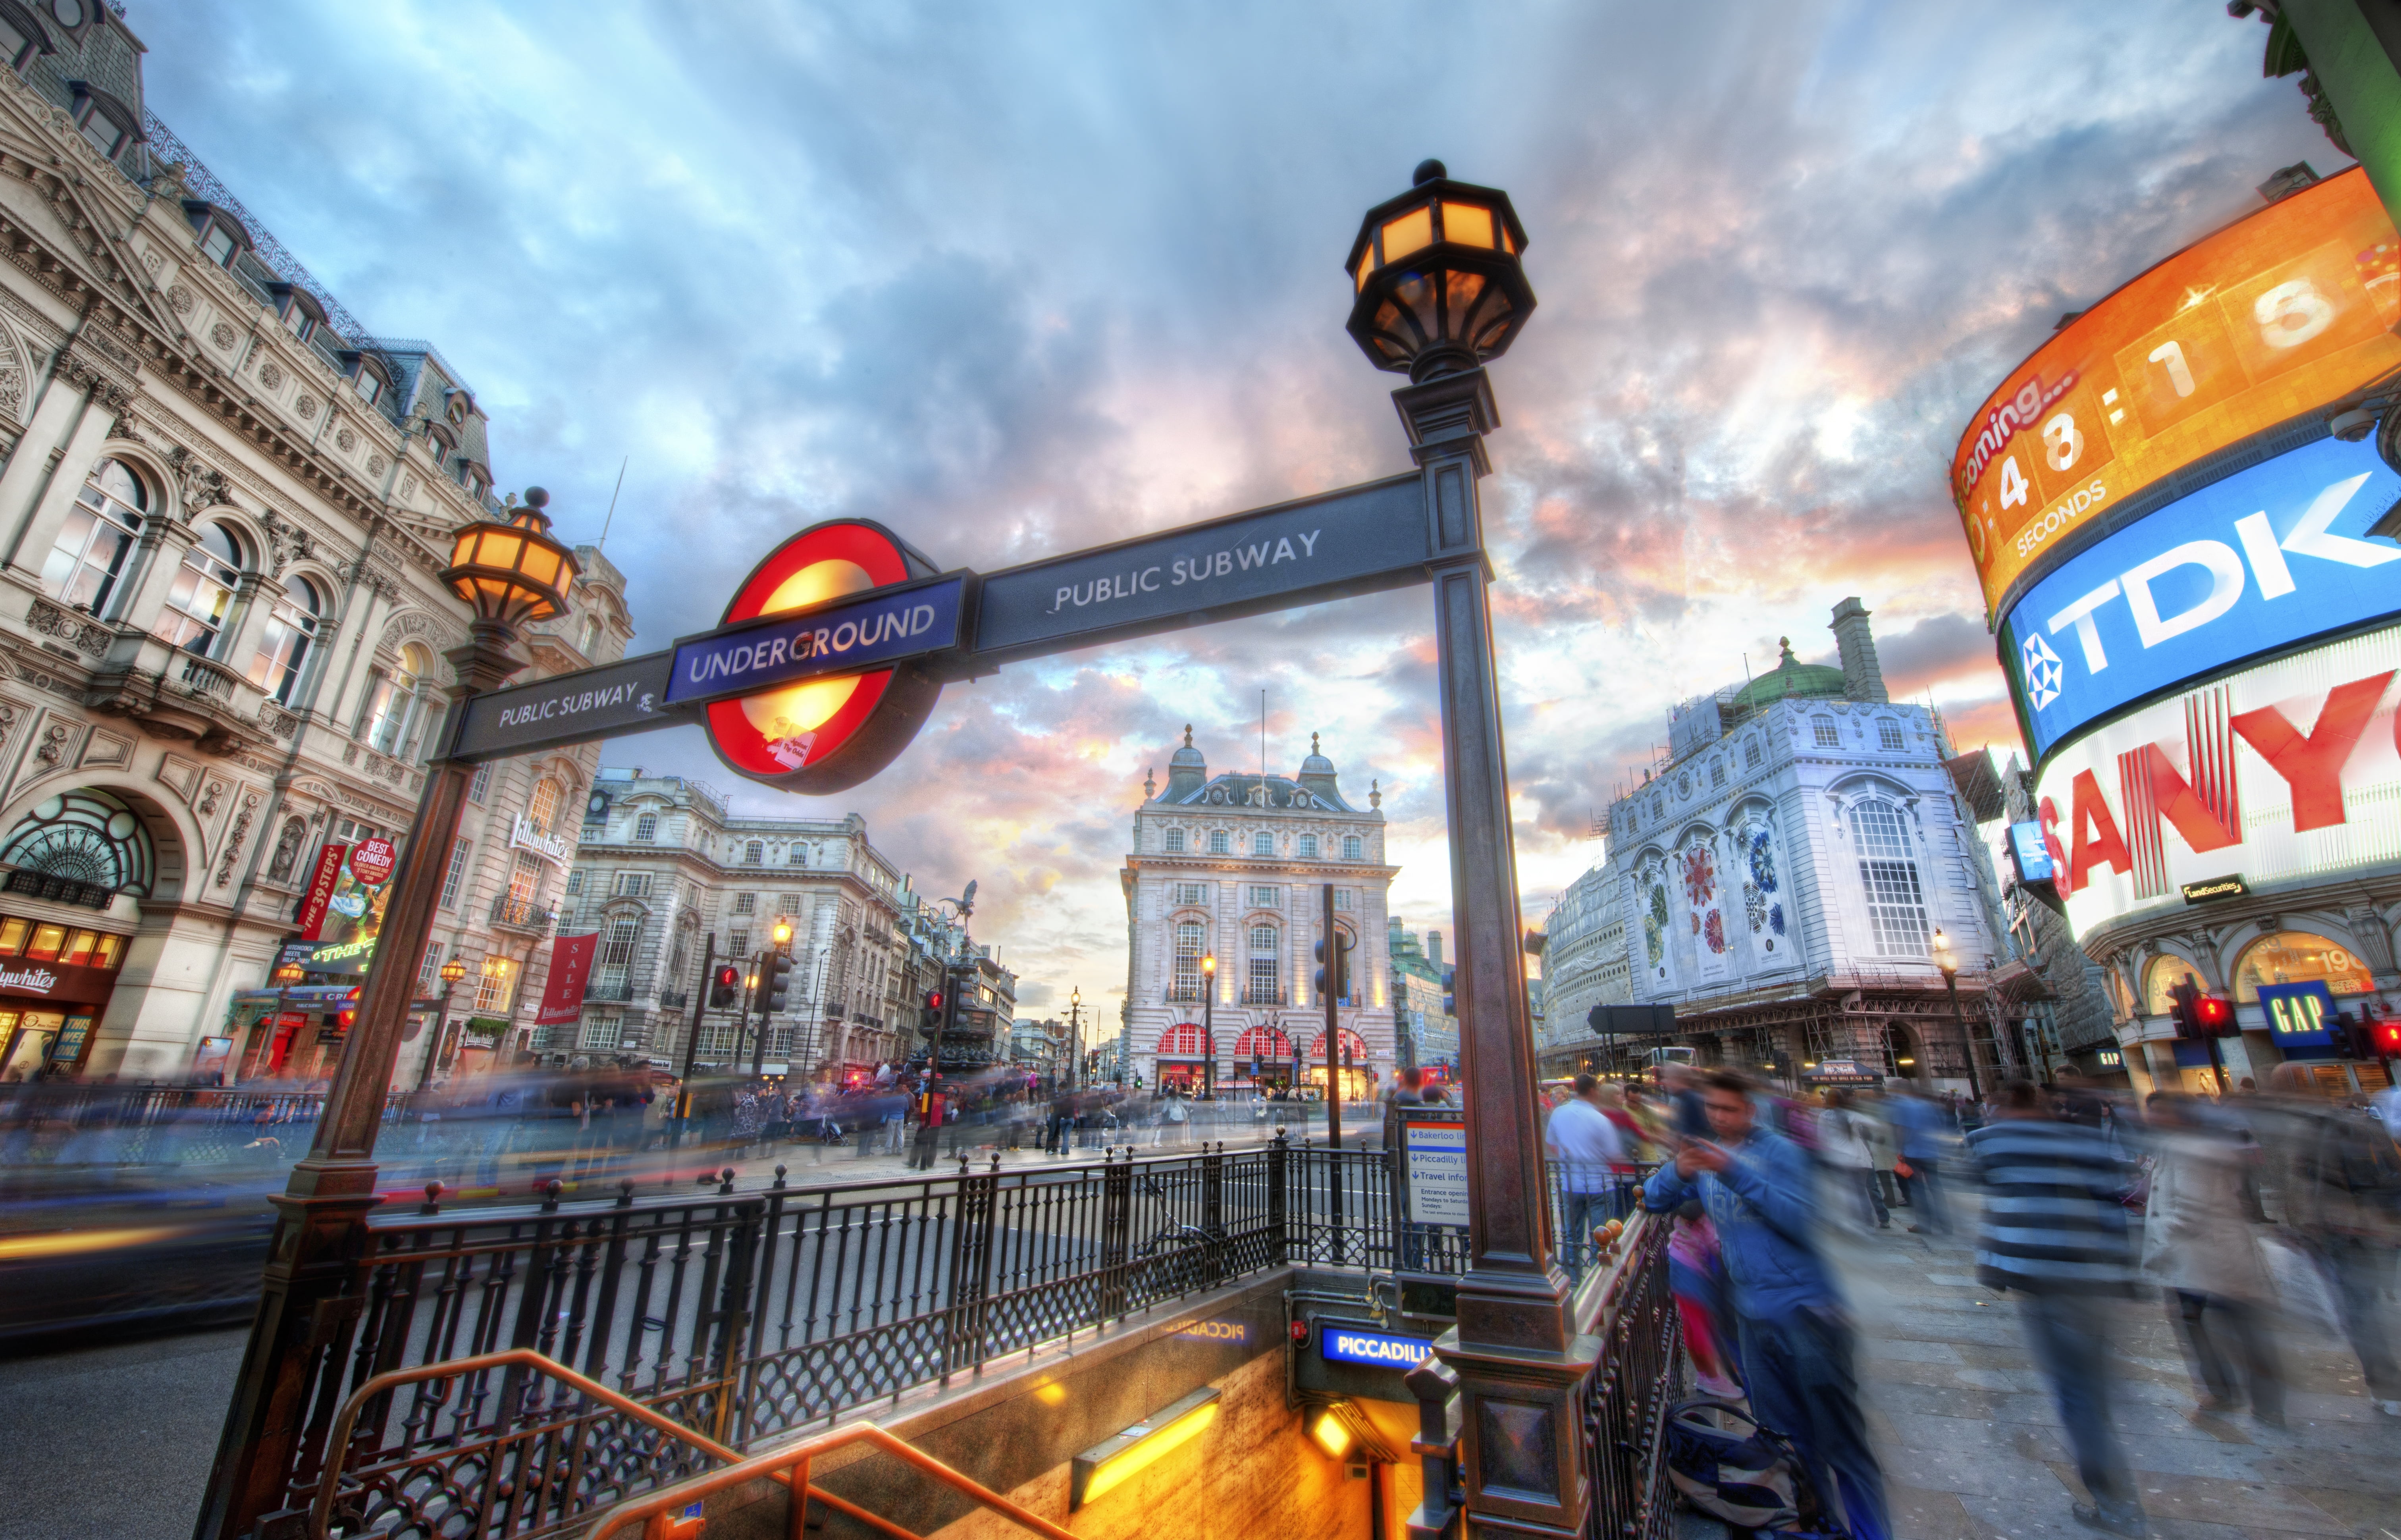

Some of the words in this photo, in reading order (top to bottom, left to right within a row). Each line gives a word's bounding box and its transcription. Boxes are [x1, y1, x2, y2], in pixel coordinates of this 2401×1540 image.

[2016, 479, 2106, 557] SECONDS
[1054, 566, 1160, 611] PUBLIC
[1171, 530, 1321, 586] SUBWAY
[2047, 471, 2401, 675] TDK
[690, 604, 935, 682] UNDERGROUND
[499, 698, 557, 728] PUBLIC
[559, 682, 639, 716] SUBWAY
[2039, 669, 2401, 902] SANY
[368, 840, 389, 855] BEST
[509, 811, 570, 868] Lillywhites
[356, 850, 392, 867] COMEDY
[312, 888, 327, 908] 39
[561, 943, 579, 999] SALE
[541, 1005, 580, 1020] Lillywhites
[2271, 996, 2325, 1033] GAP
[464, 1029, 495, 1049] Lillywhites
[2100, 1052, 2120, 1065] GAP
[1418, 1131, 1454, 1139] Bakerloo
[1420, 1154, 1458, 1165] Piccadilly
[1420, 1172, 1445, 1181] Travel
[1338, 1336, 1434, 1363] PICCADILL
